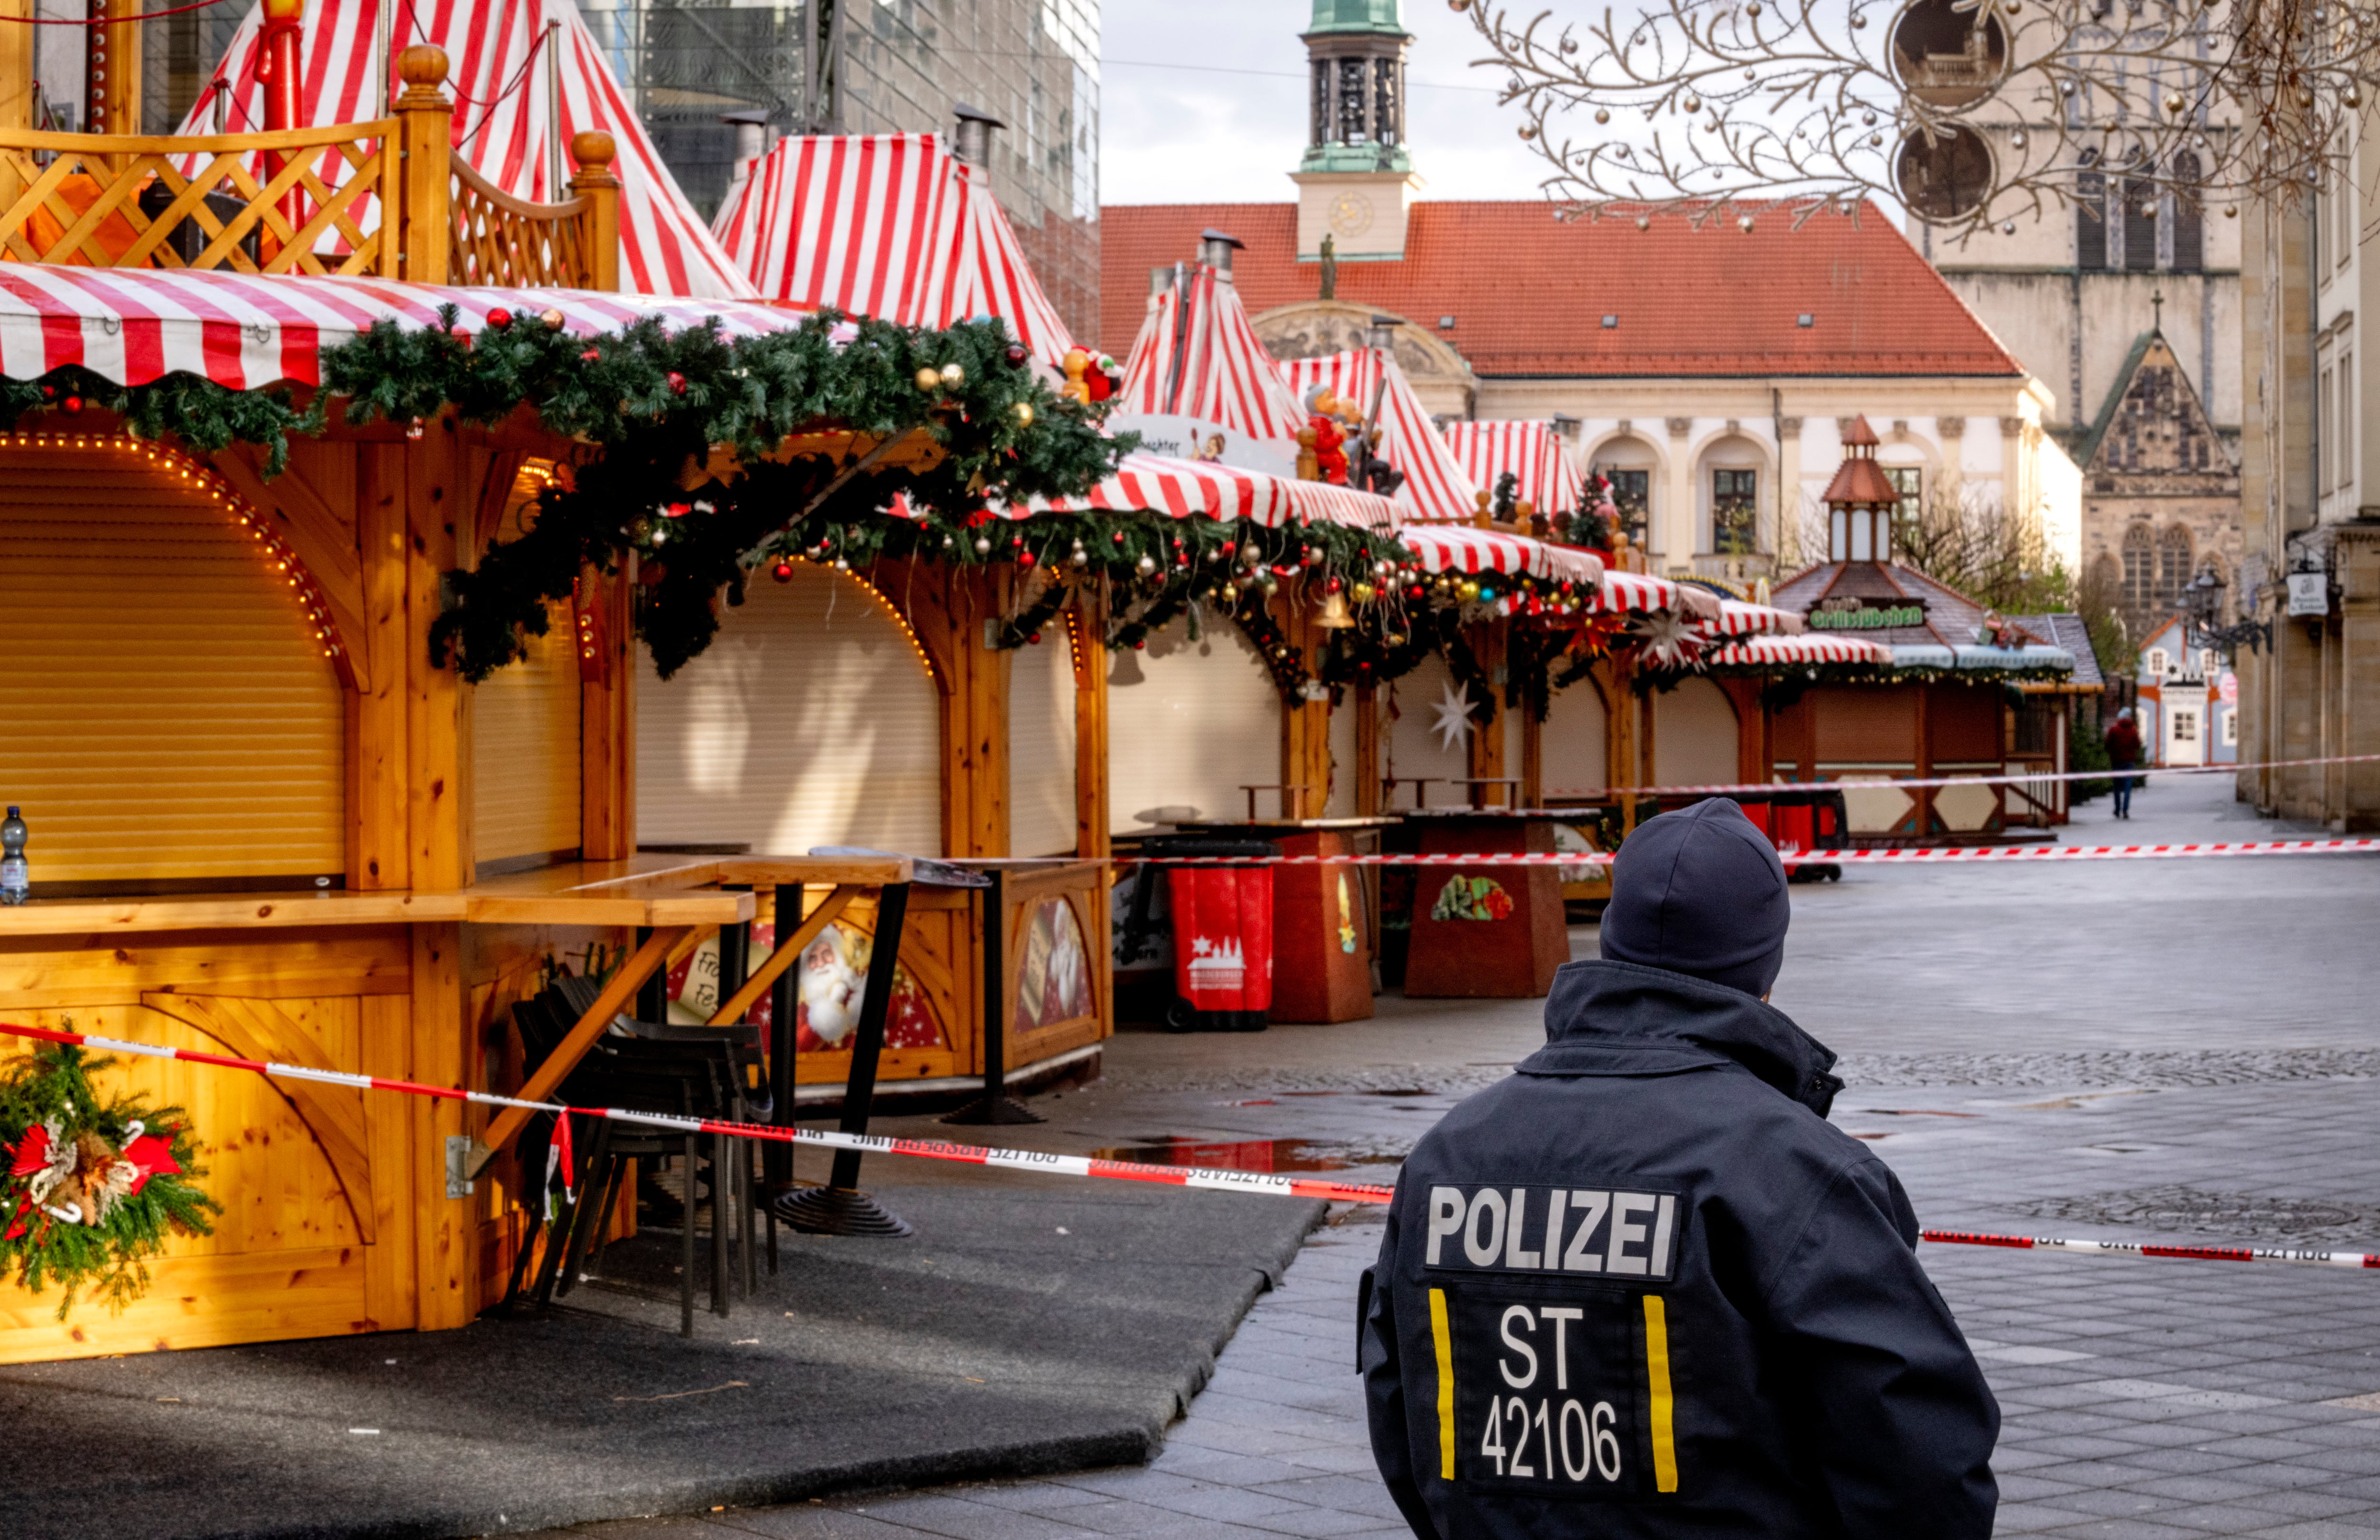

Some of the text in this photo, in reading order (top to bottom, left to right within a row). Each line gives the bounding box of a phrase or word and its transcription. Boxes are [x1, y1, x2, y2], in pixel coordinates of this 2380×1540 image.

[1426, 1186, 1675, 1277] POLIZEI
[1499, 1305, 1583, 1390] ST
[1482, 1395, 1621, 1481] 42106
